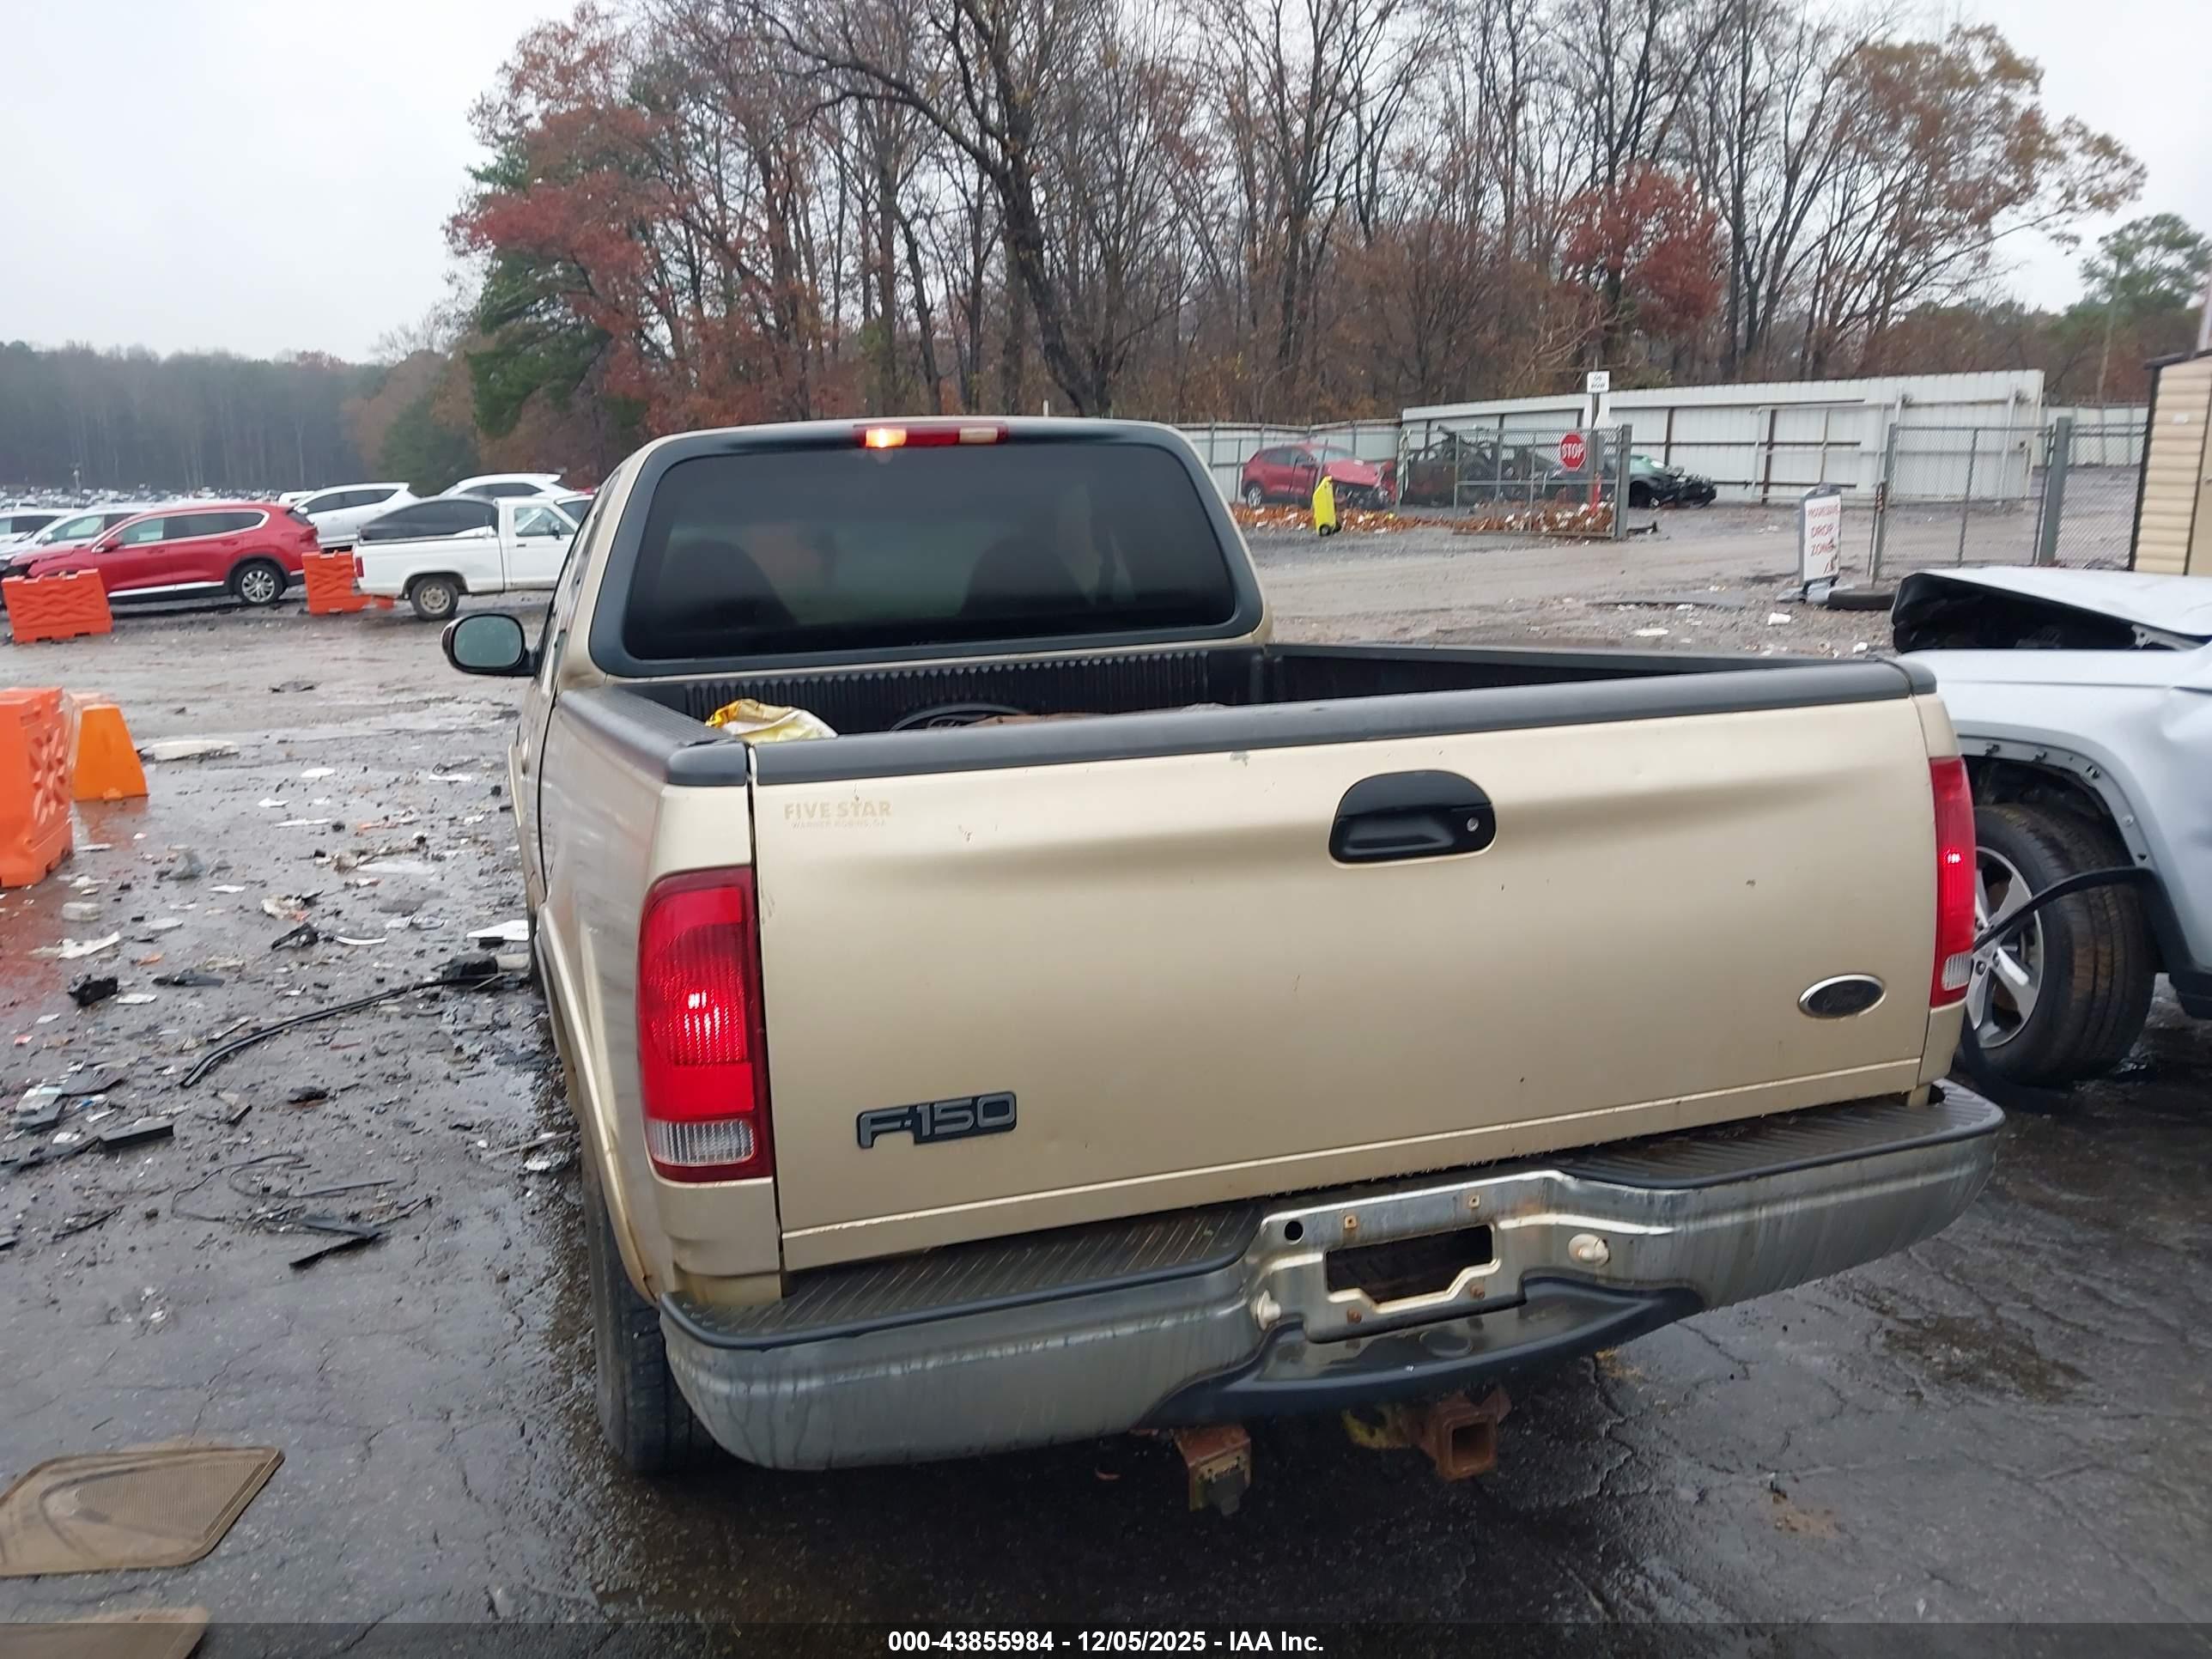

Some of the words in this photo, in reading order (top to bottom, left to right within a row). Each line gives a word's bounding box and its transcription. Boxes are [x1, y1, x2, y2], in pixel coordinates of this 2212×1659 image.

[1562, 442, 1584, 459] STOP
[1811, 523, 1834, 538] DROP
[784, 802, 831, 820] FIVE
[836, 799, 892, 818] STAR
[859, 1091, 1017, 1149] F-150
